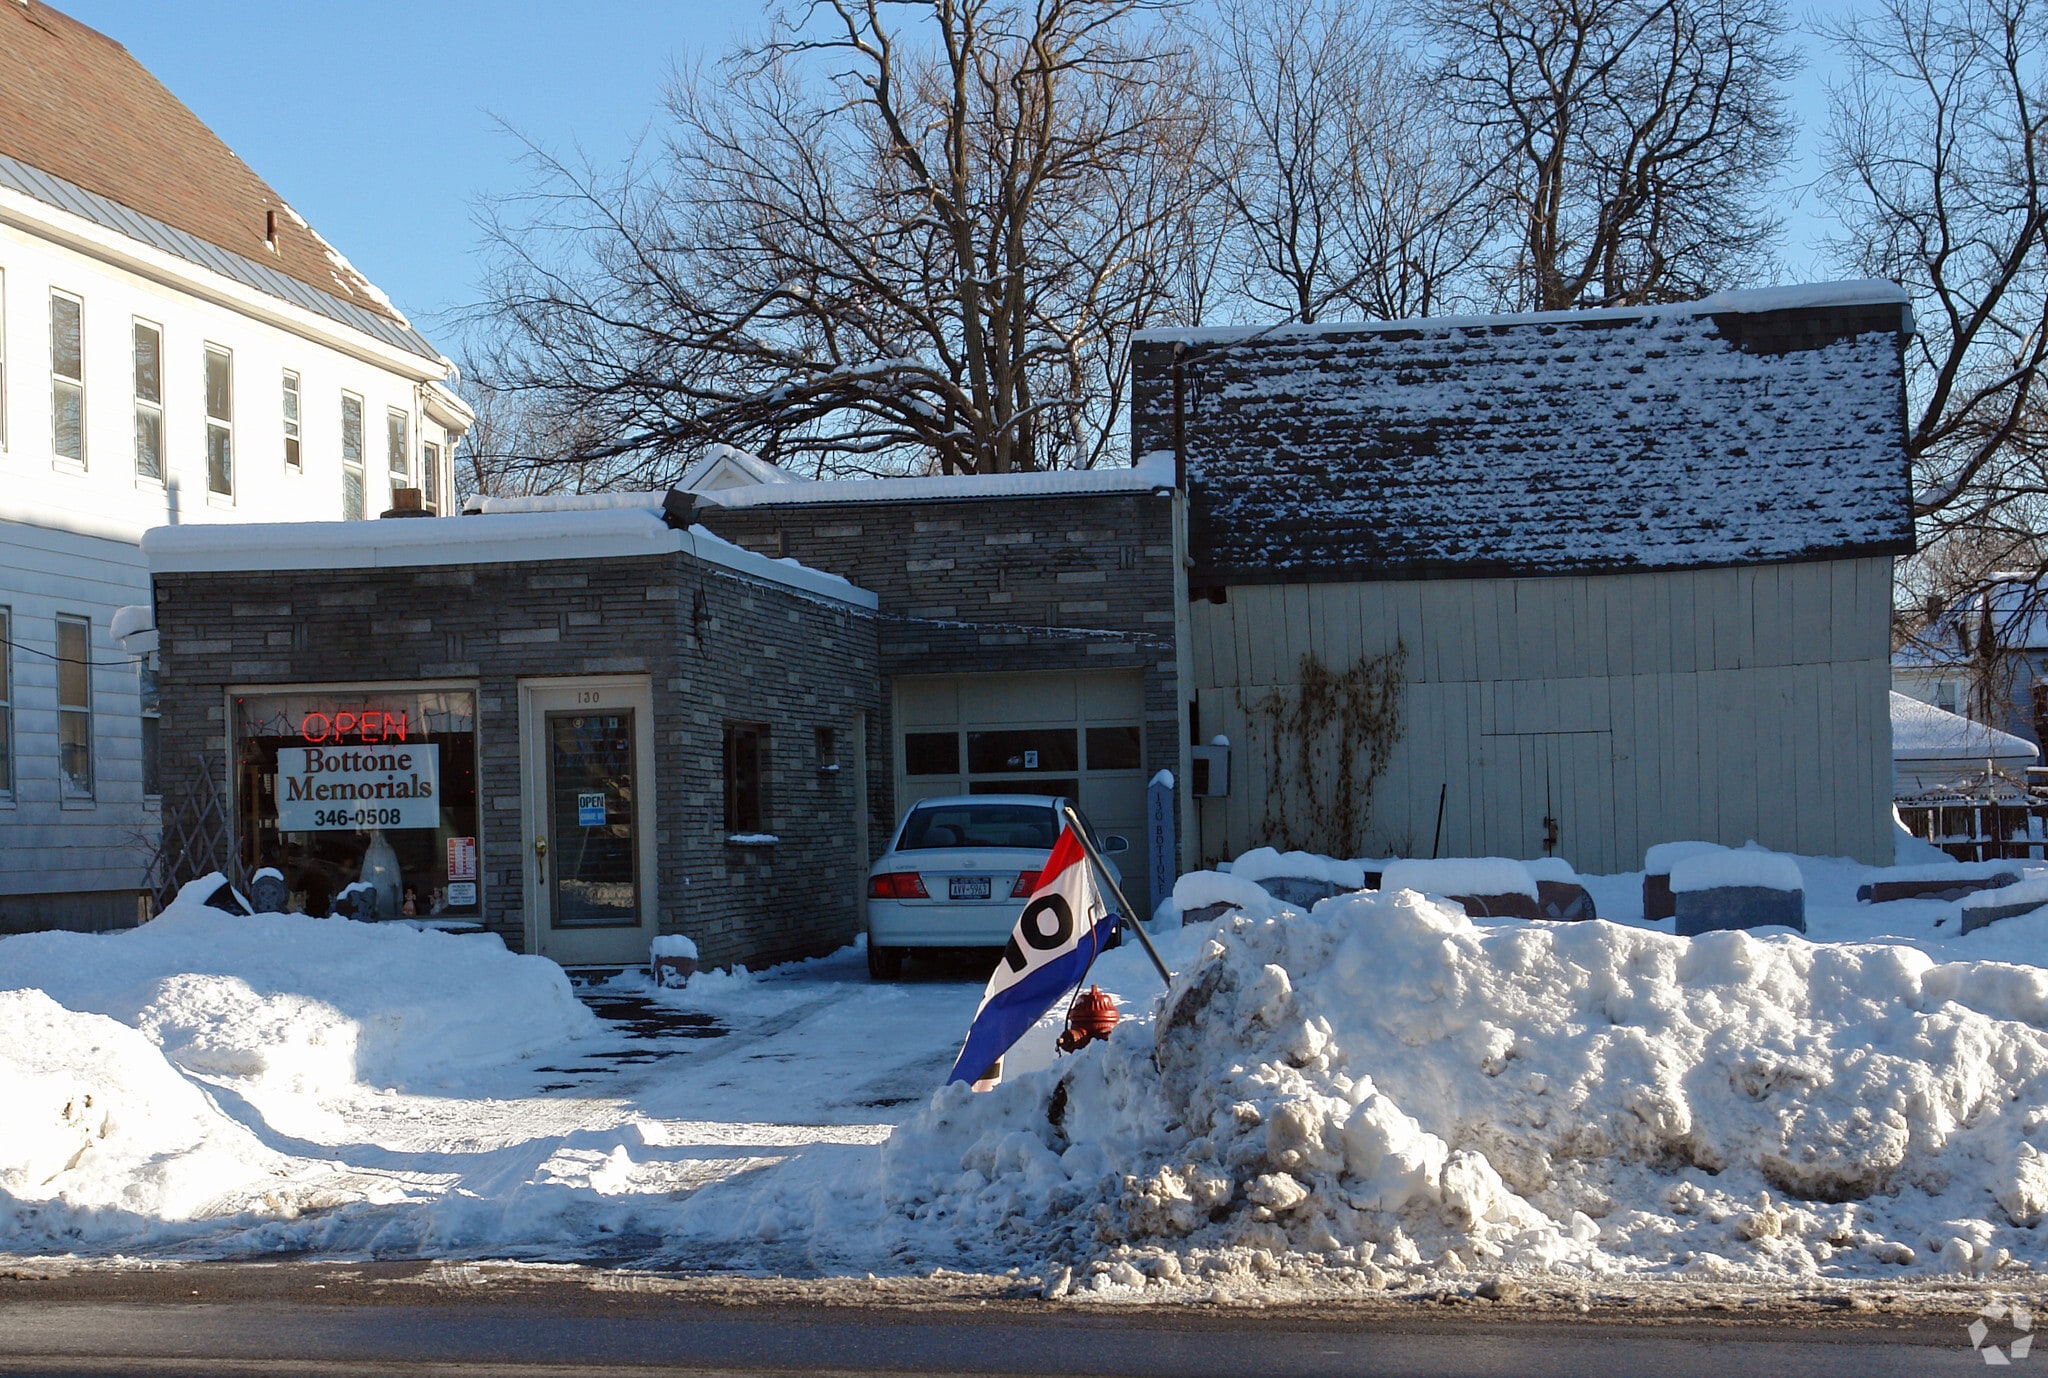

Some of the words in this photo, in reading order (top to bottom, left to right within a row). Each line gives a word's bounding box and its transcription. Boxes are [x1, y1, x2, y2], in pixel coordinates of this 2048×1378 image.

[578, 692, 600, 703] 130
[302, 711, 407, 743] OPEN
[303, 748, 413, 774] Bottone
[287, 774, 433, 801] Memorials
[580, 796, 604, 808] OPEN
[1155, 792, 1163, 820] 130
[315, 808, 401, 827] 346-0508
[1156, 826, 1165, 894] BOTTONE
